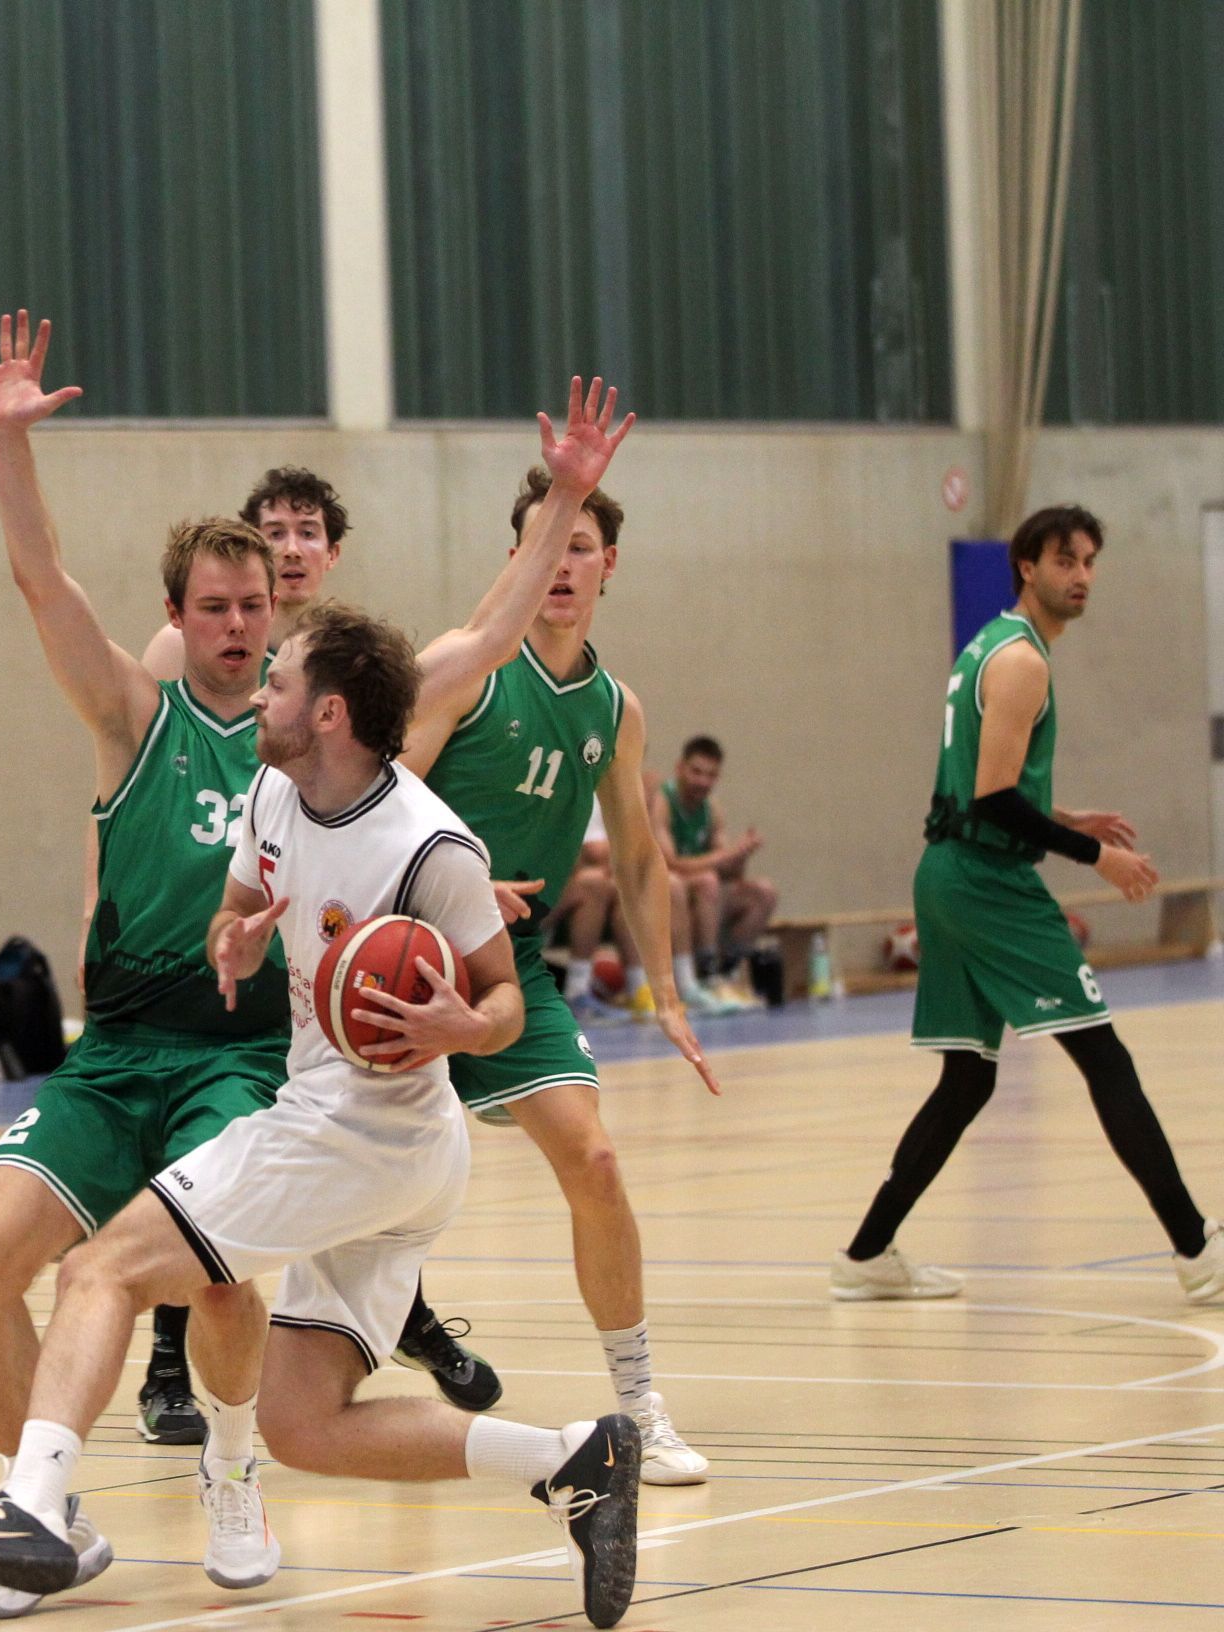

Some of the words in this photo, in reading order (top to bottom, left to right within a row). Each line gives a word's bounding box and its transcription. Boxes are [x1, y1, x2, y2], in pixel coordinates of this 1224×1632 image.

[515, 746, 564, 799] 11
[260, 839, 281, 859] AKO
[1077, 964, 1102, 1004] 6
